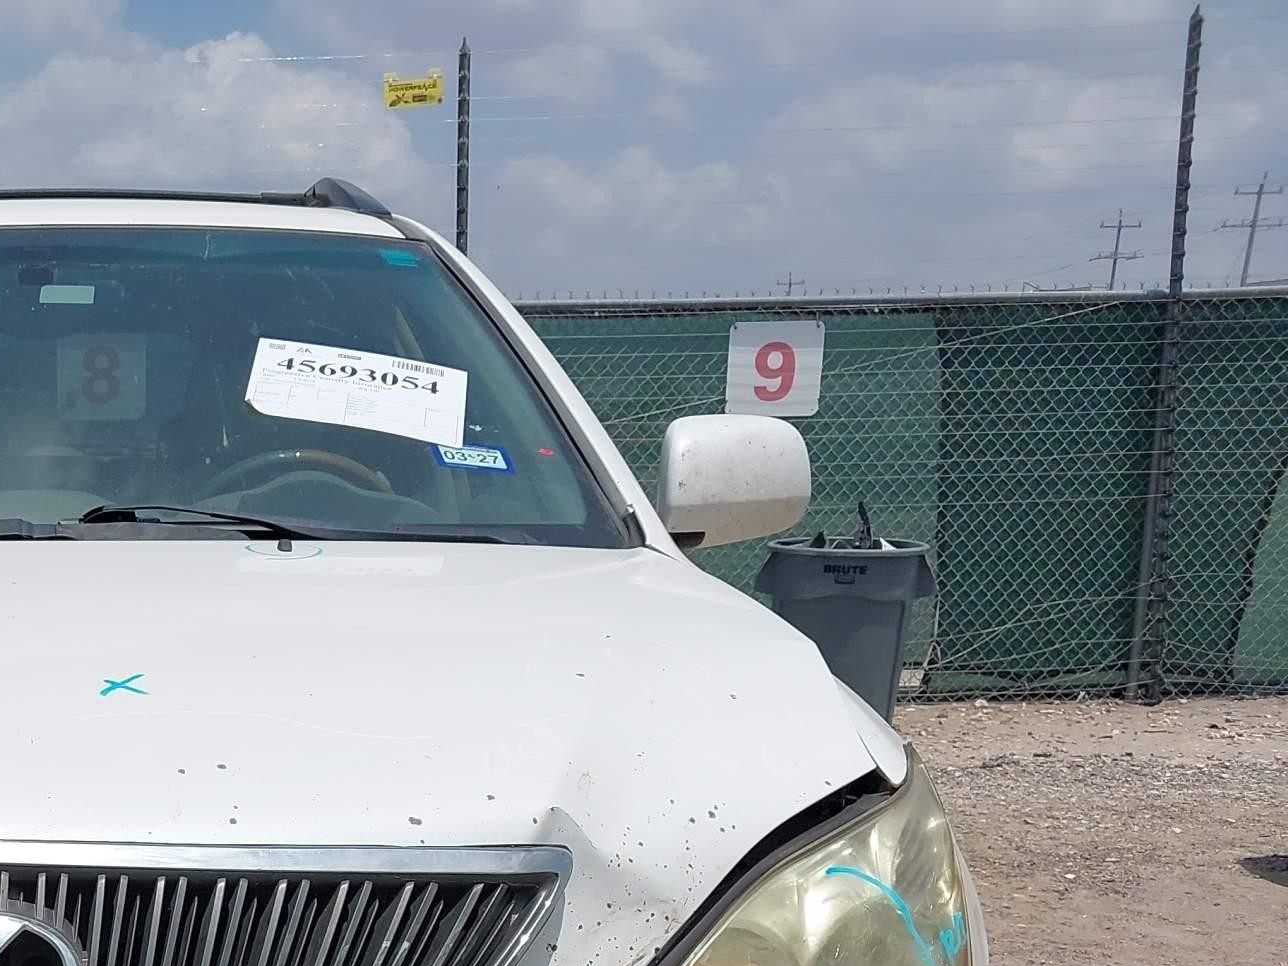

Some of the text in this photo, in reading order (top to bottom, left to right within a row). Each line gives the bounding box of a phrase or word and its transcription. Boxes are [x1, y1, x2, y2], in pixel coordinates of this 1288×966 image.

[81, 345, 121, 404] 8
[277, 357, 439, 394] 45693054
[753, 341, 796, 401] 9
[823, 565, 868, 575] BRUTE
